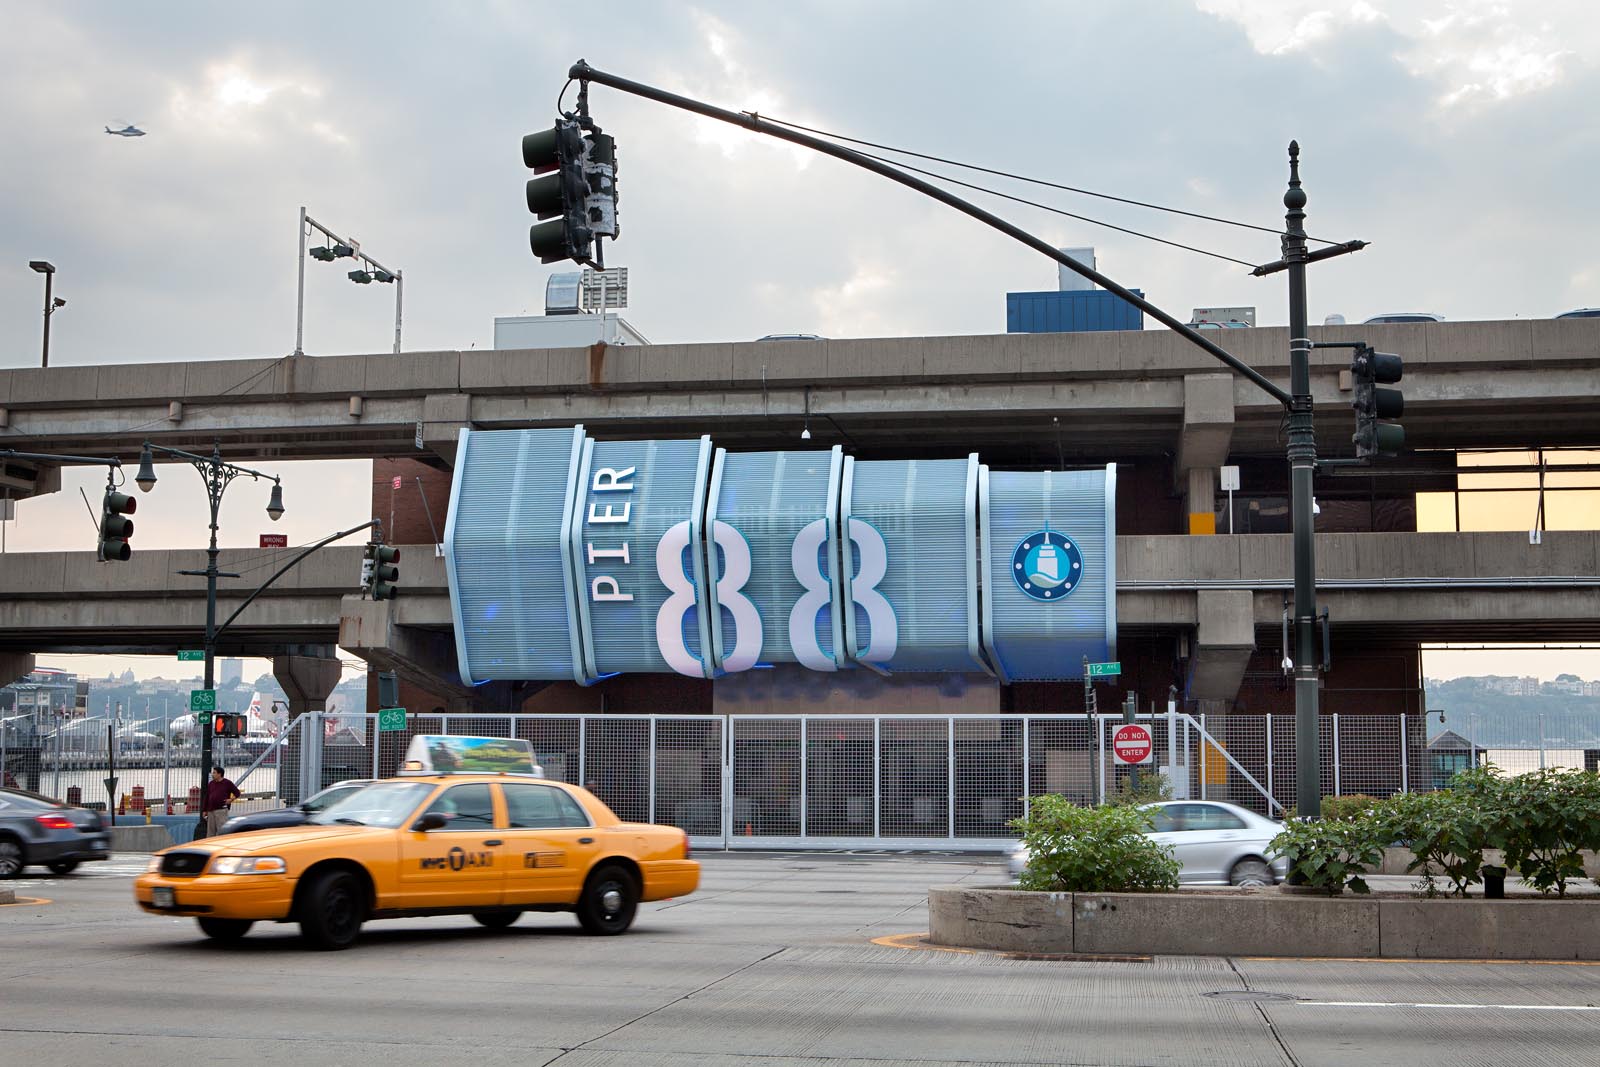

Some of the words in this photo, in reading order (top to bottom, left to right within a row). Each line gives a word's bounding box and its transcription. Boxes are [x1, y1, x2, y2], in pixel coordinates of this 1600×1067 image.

[588, 466, 636, 601] PIER
[656, 516, 897, 678] 88
[181, 652, 189, 660] 12
[1092, 664, 1103, 674] 12
